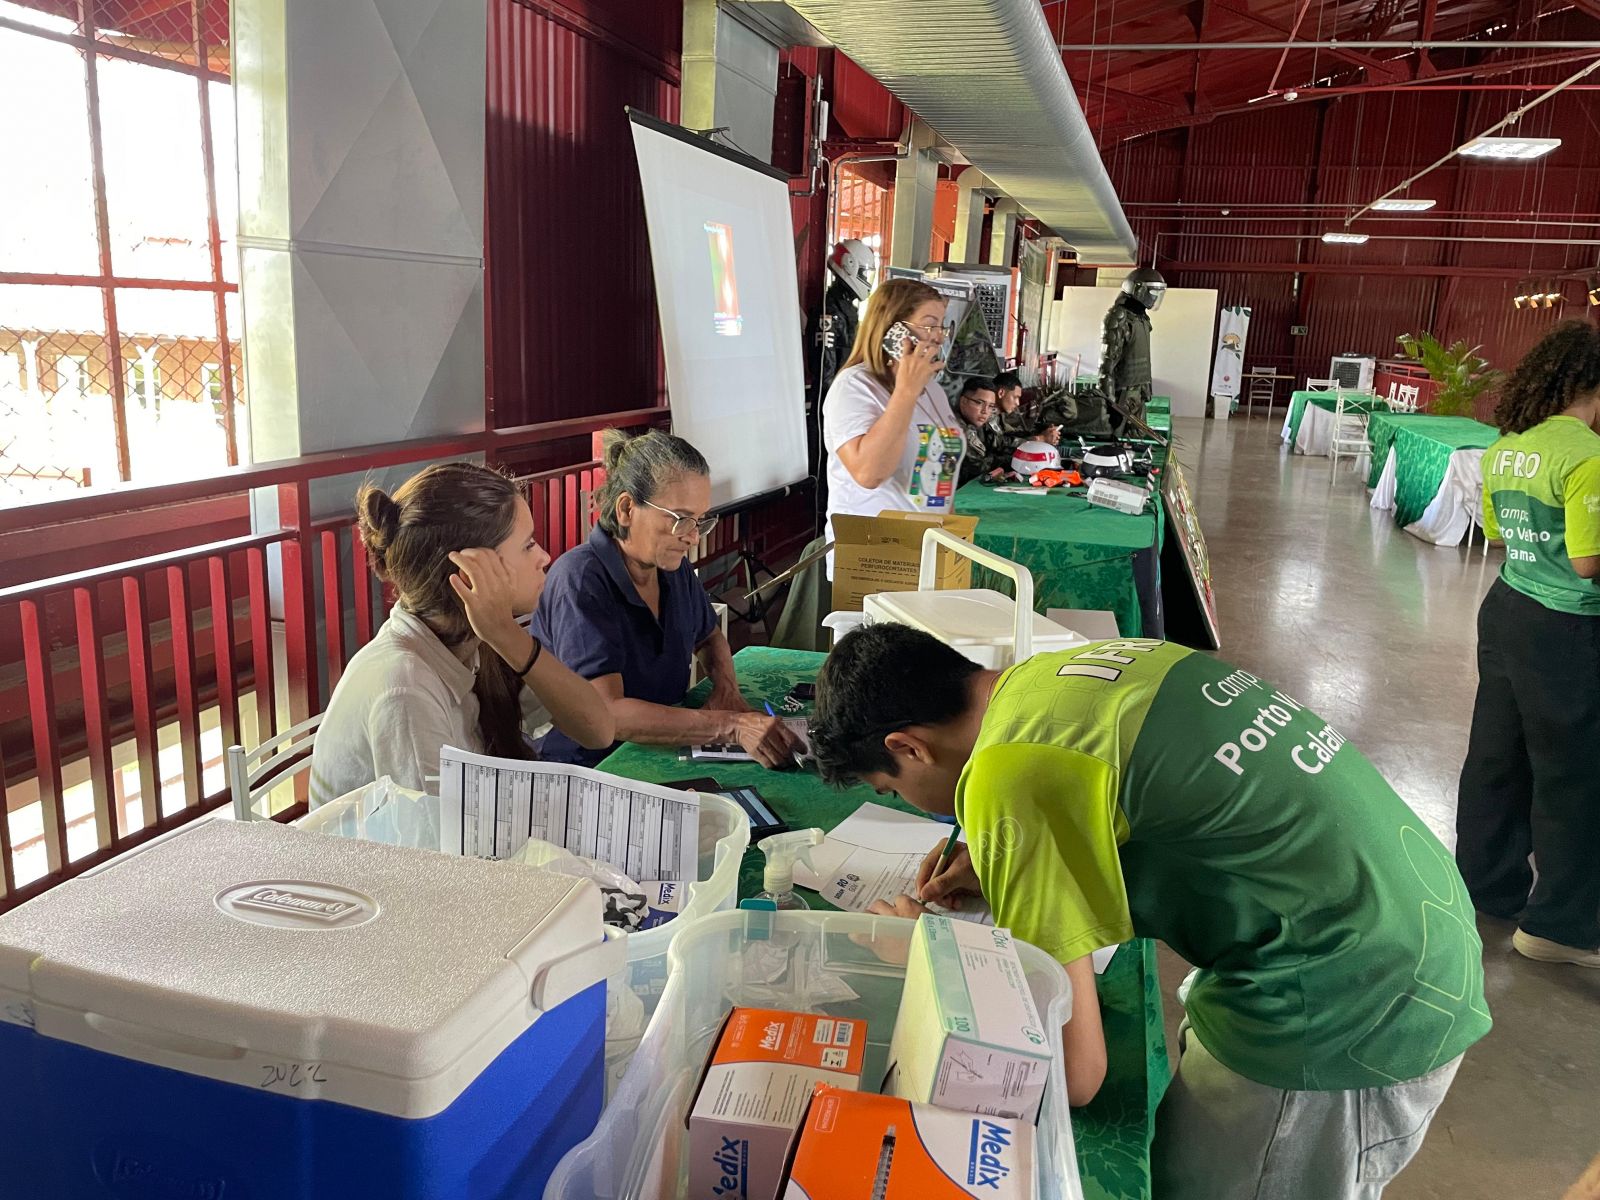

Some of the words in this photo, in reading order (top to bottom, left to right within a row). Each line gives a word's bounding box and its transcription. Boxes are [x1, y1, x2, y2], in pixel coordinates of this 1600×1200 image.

[1491, 449, 1541, 479] IFRO
[1201, 668, 1263, 707] Camp
[1213, 700, 1292, 776] Porto
[662, 882, 677, 905] Medix
[758, 1021, 781, 1050] Medix
[976, 1119, 1012, 1190] Medix
